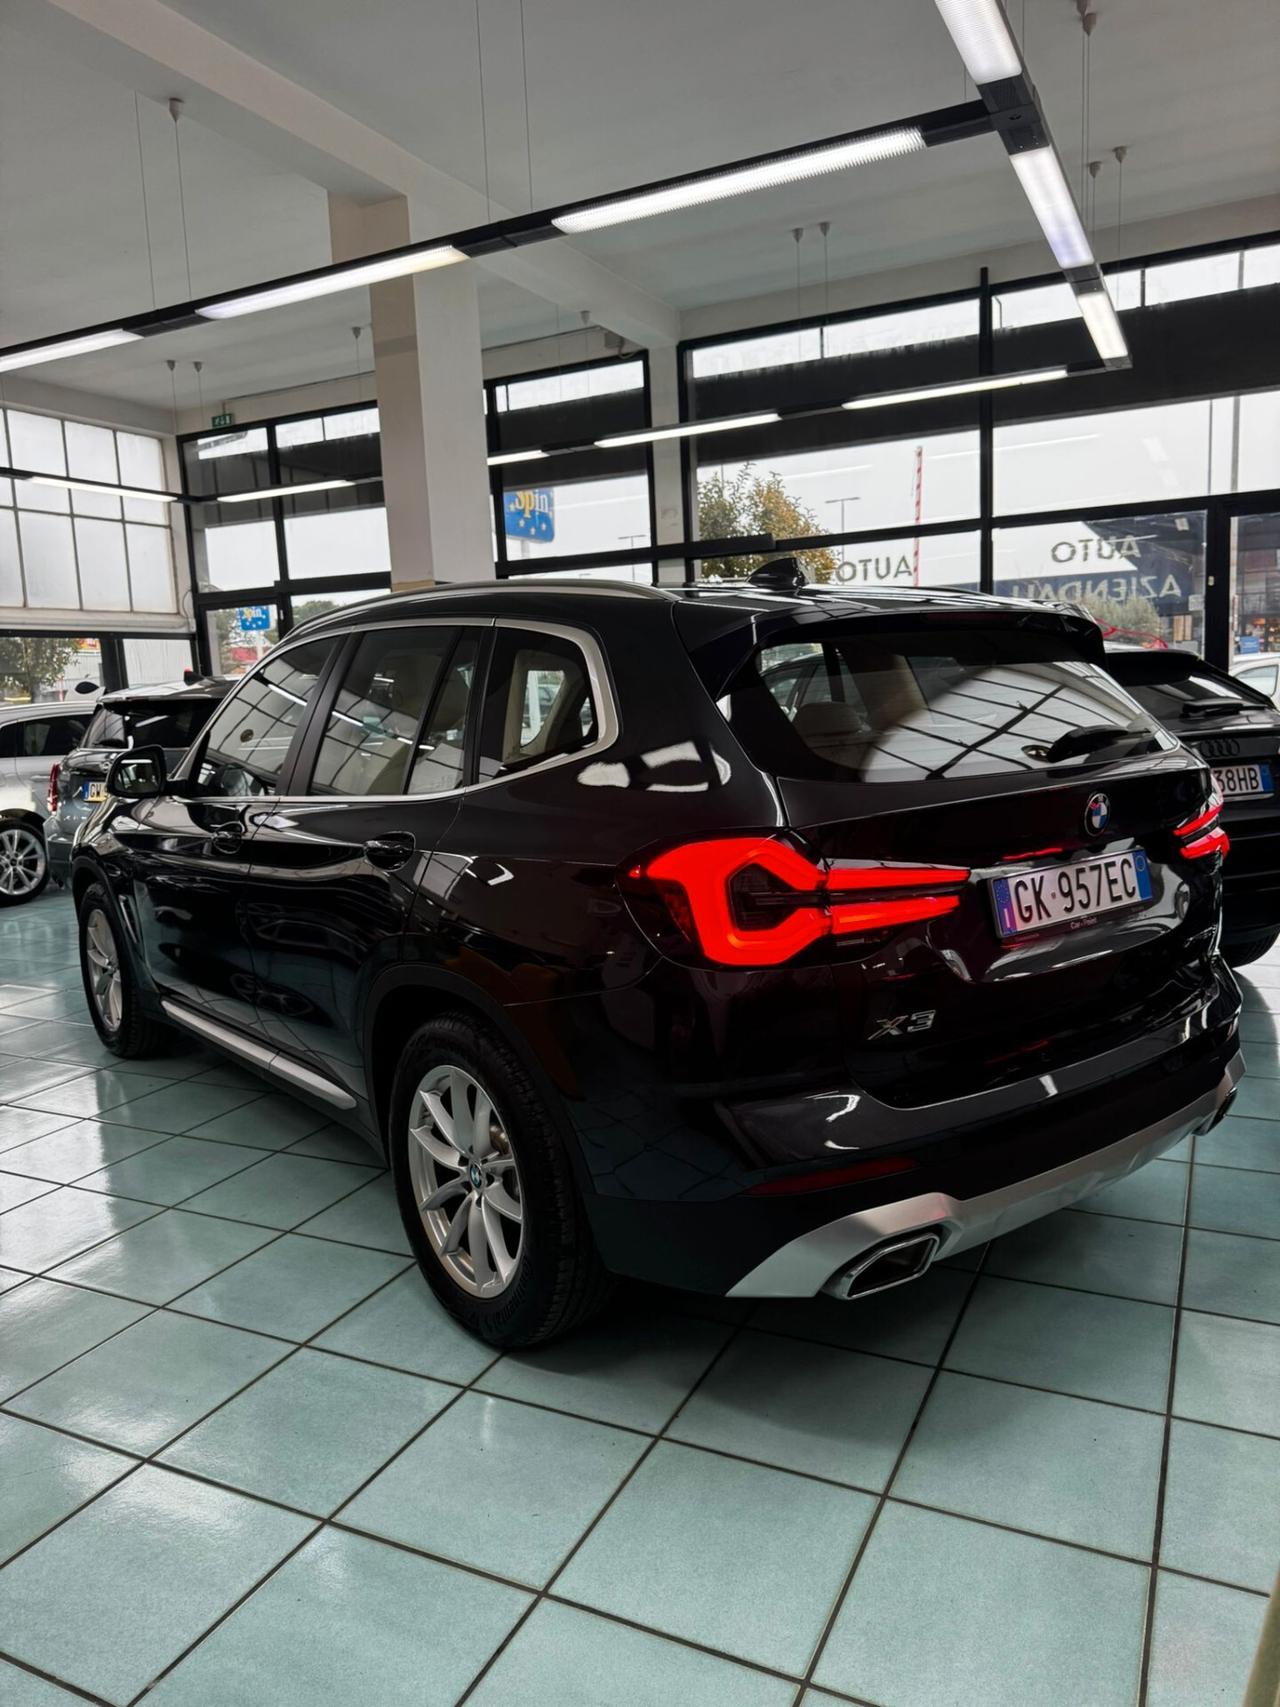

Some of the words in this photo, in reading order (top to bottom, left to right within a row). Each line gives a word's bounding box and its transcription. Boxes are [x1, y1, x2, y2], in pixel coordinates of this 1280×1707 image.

[1213, 767, 1260, 793] 38HB
[1014, 875, 1052, 924] GK
[1057, 857, 1137, 913] 957EC
[867, 1009, 936, 1041] X3
